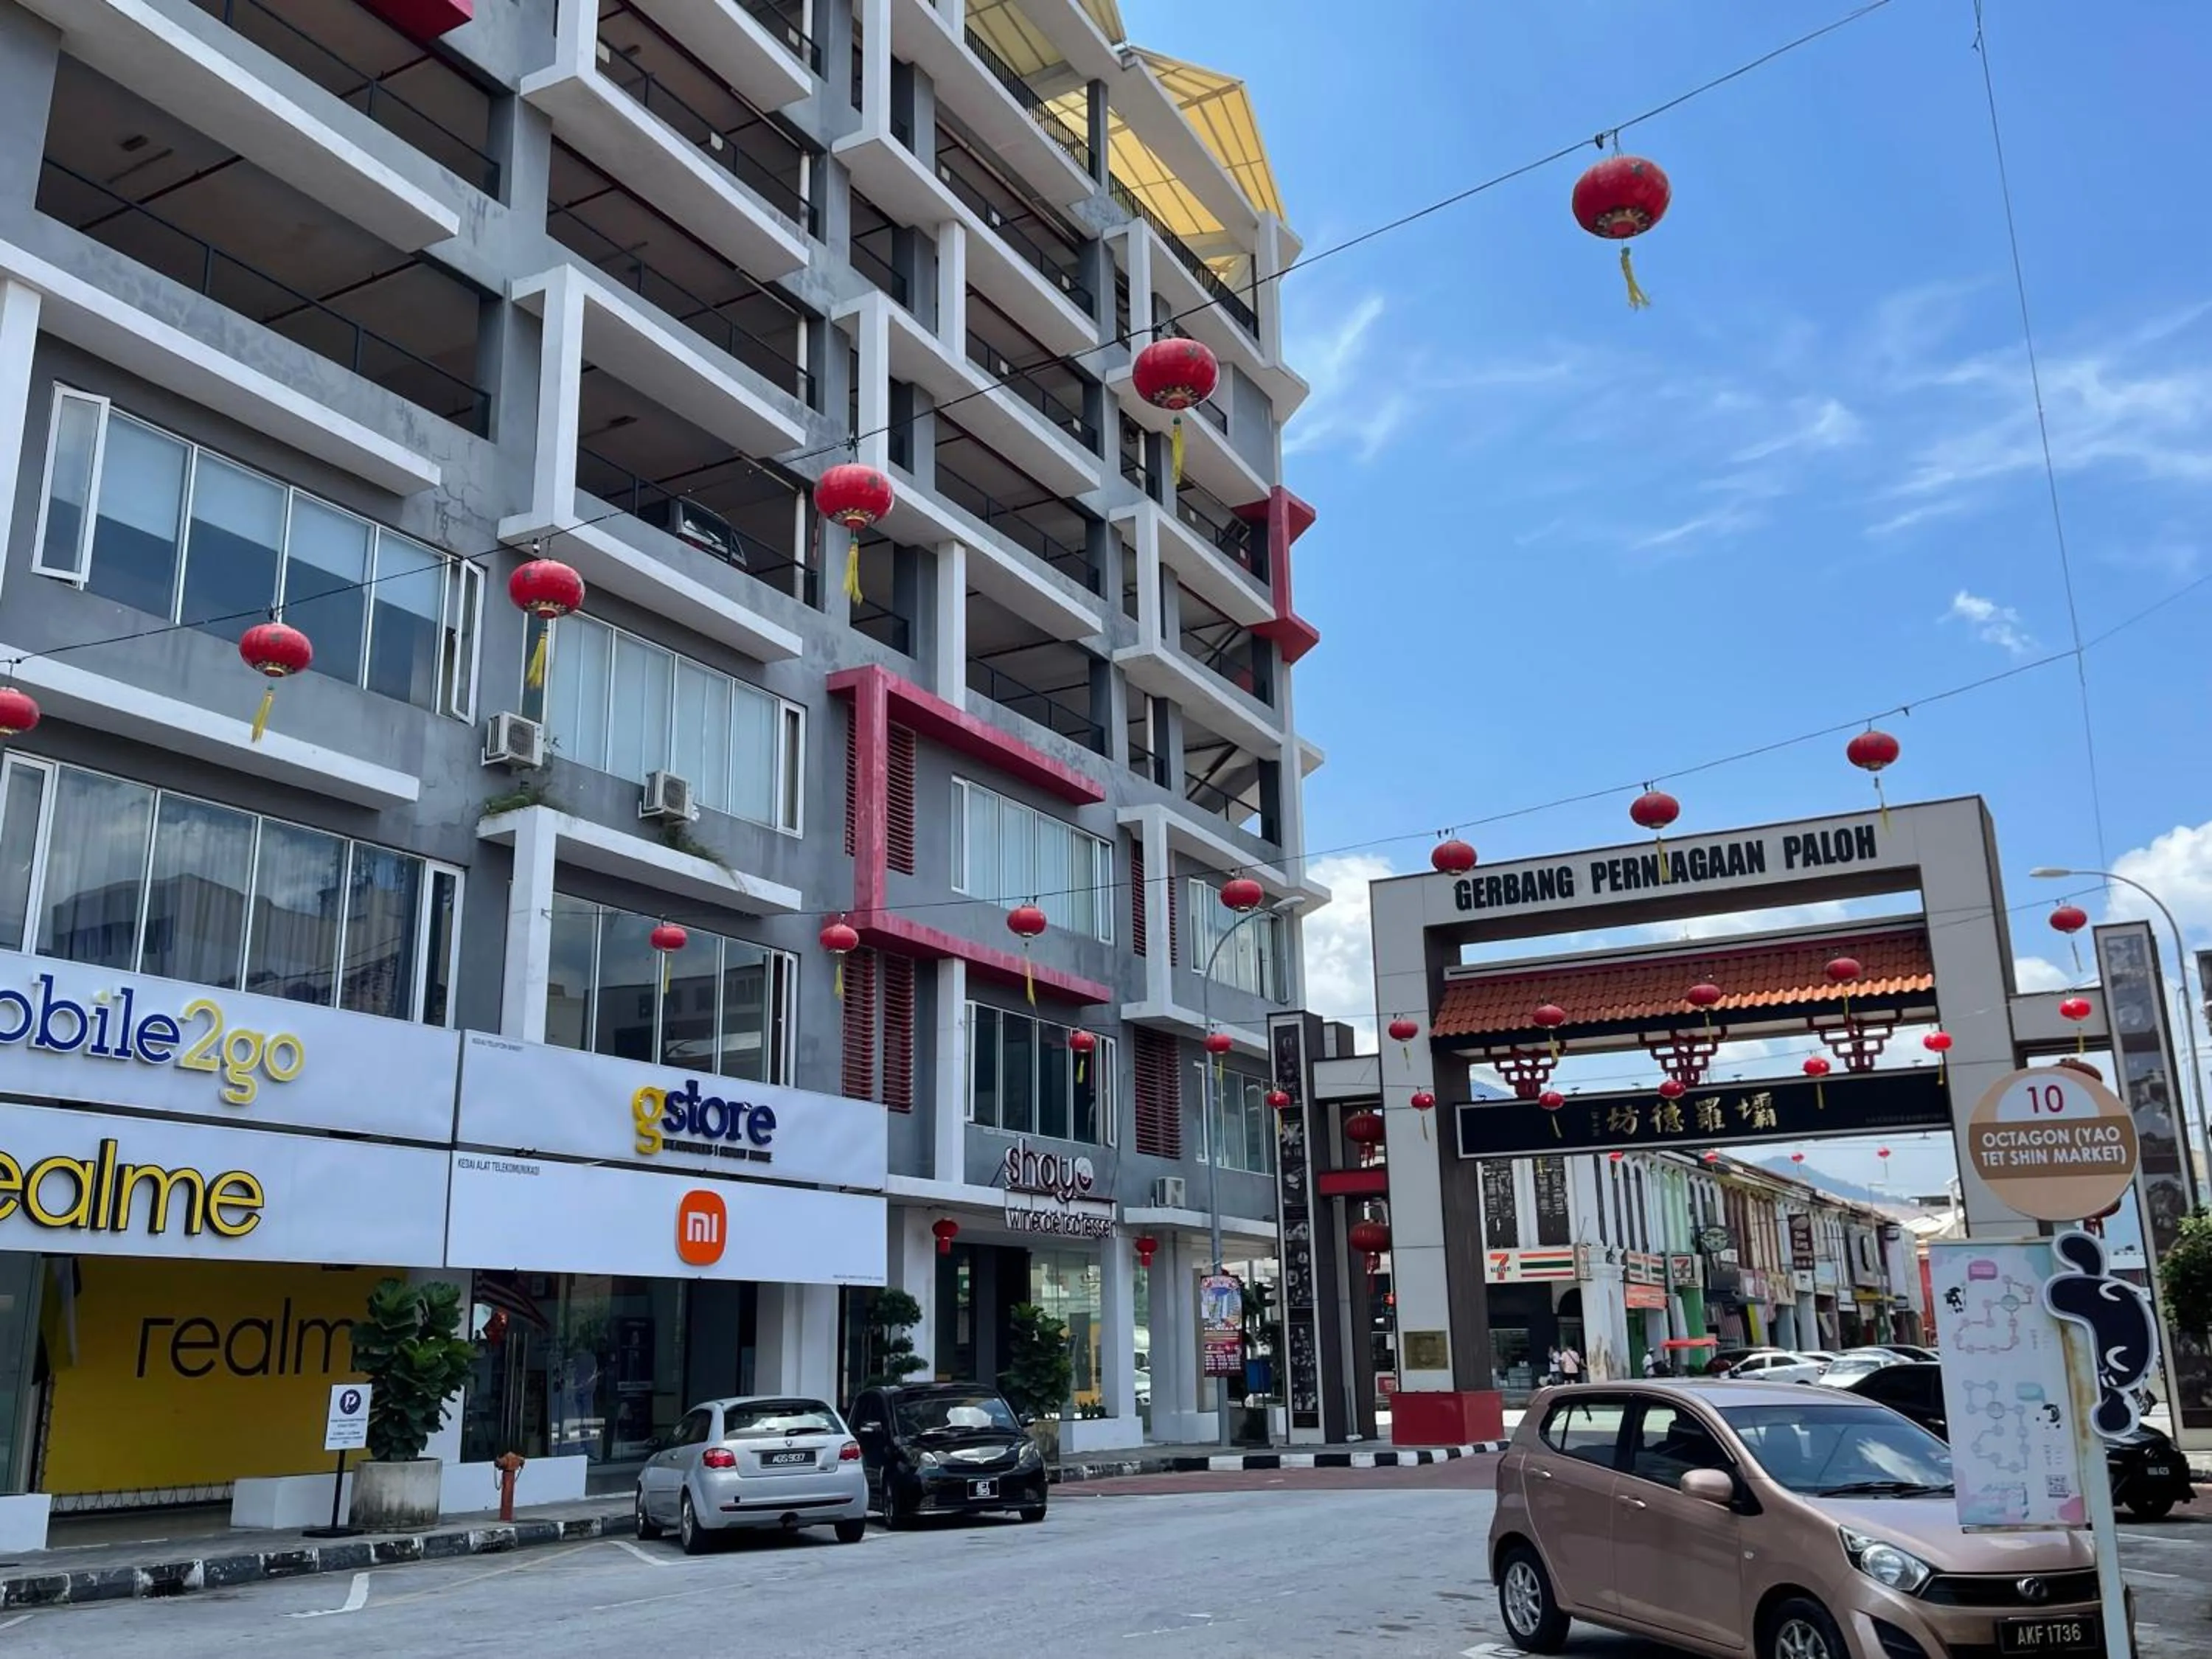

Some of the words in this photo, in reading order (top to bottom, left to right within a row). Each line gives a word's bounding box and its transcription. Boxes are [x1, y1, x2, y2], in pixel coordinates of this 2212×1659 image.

[1454, 866, 1575, 911] GERBANG
[1784, 824, 1877, 869] PALOH
[2026, 1085, 2065, 1113] 10
[633, 1079, 776, 1155] gstore
[1982, 1128, 2070, 1148] OCTAGON
[2075, 1126, 2121, 1147] (YAO
[1980, 1150, 2006, 1166] TET
[2009, 1149, 2049, 1166] SHIN
[2053, 1144, 2127, 1165] MARKET)
[2017, 1624, 2043, 1645] AKF
[2047, 1623, 2081, 1644] 1736
